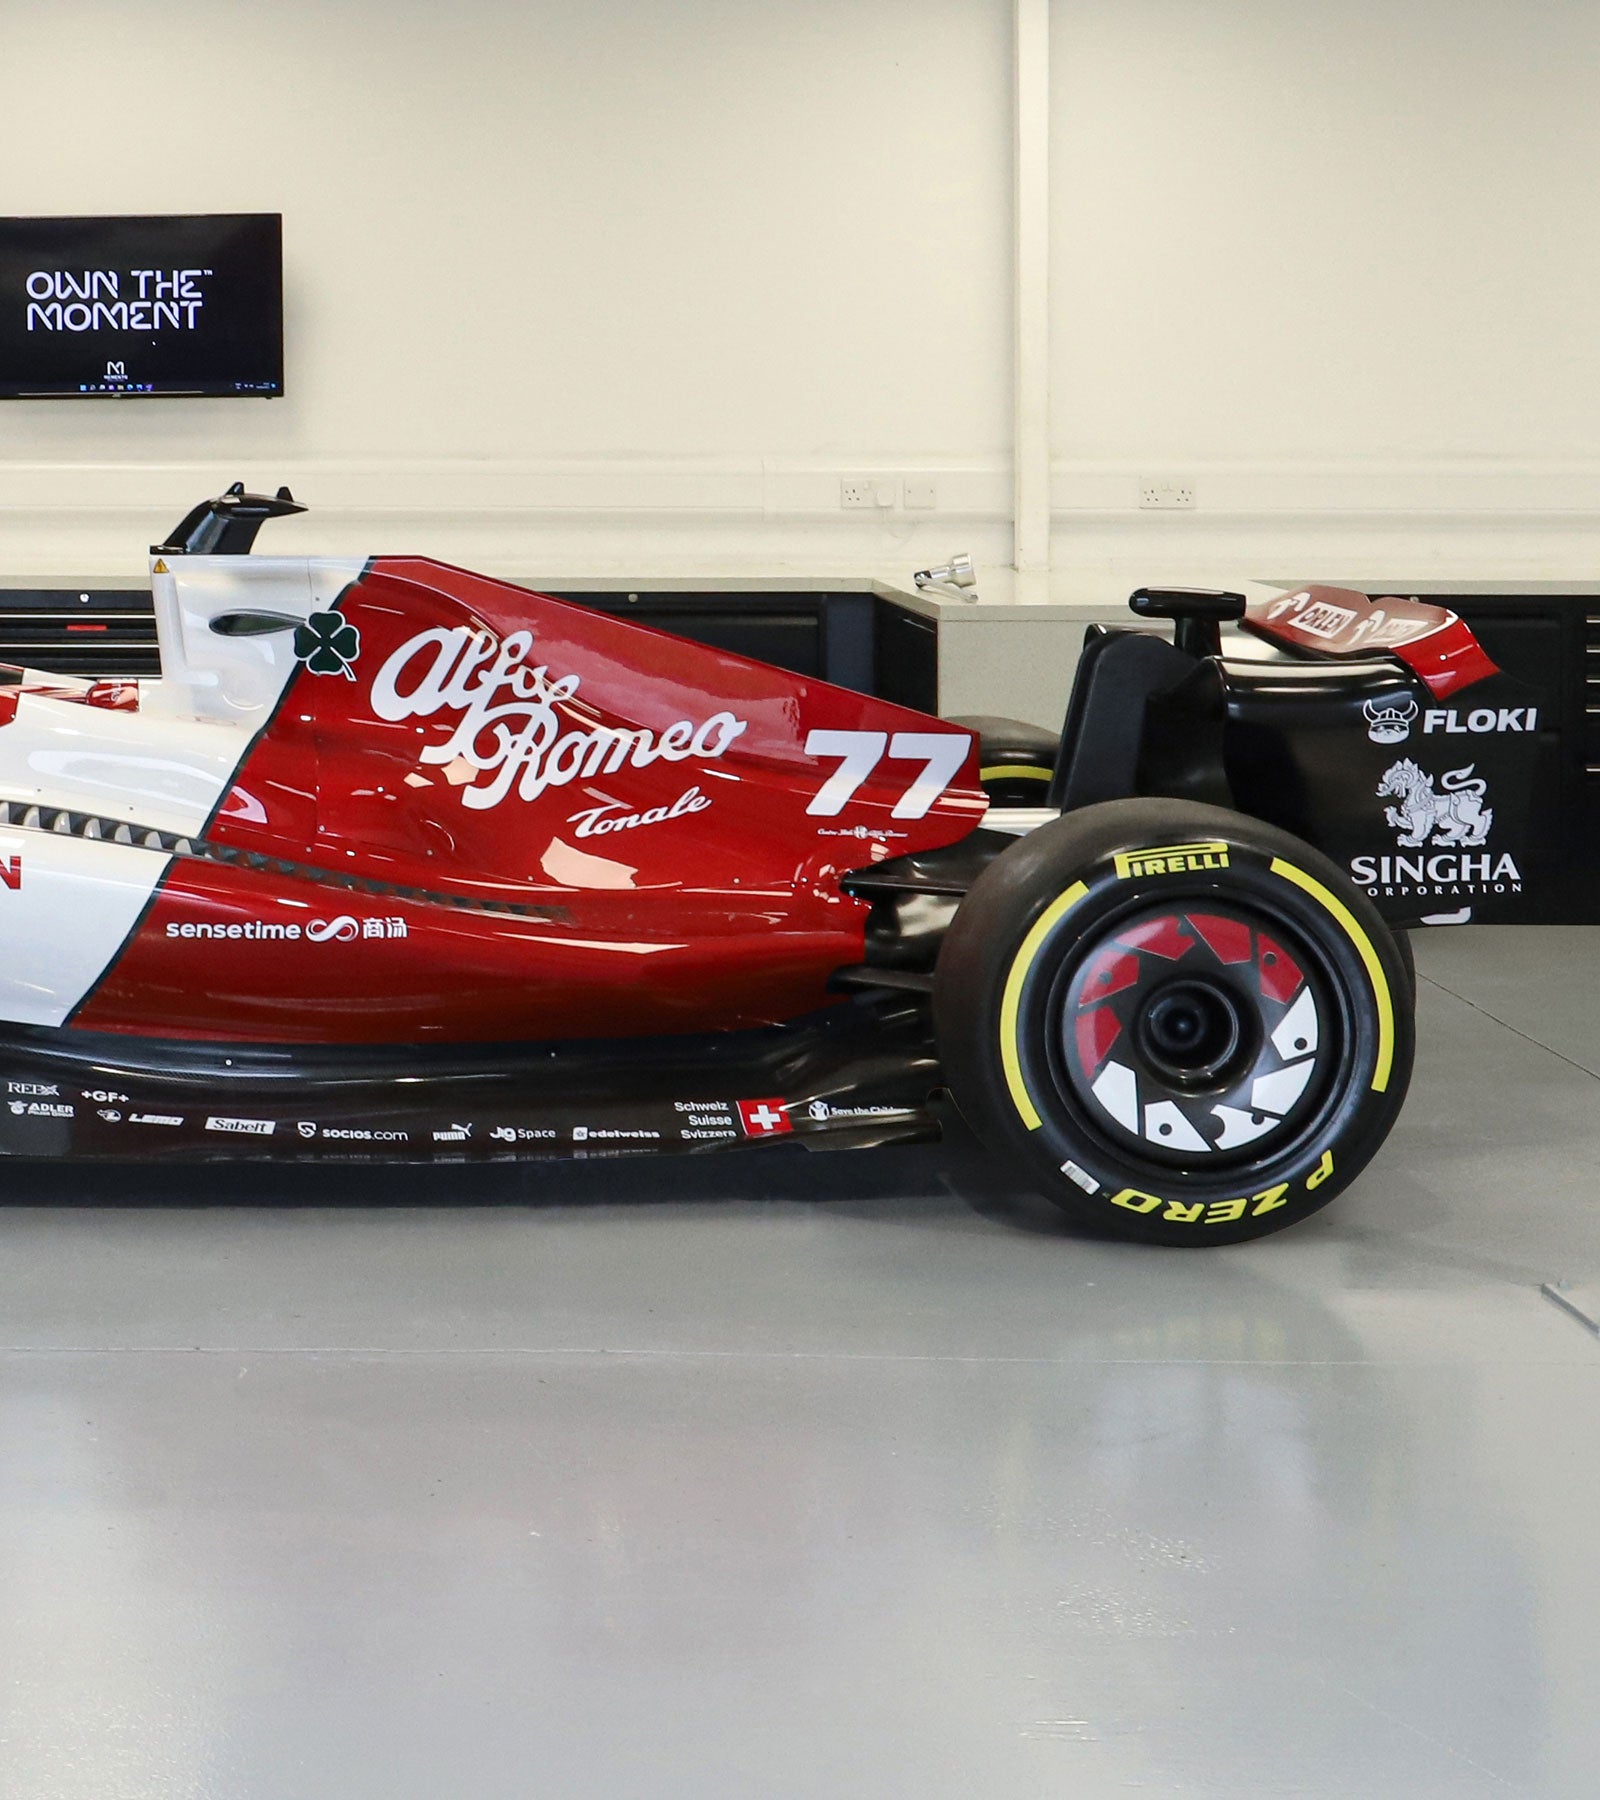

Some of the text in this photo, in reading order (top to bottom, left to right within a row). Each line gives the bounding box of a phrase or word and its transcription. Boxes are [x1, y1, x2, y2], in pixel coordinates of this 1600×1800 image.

[26, 271, 118, 299] OWN
[131, 269, 202, 298] THE
[27, 301, 202, 330] MOMENT
[1423, 708, 1537, 734] FLOKI
[419, 701, 748, 810] Romeo
[804, 729, 972, 819] 77
[566, 786, 712, 838] Tonale
[1113, 843, 1230, 880] PIRELLI
[1350, 852, 1521, 885] SINGHA
[1366, 883, 1522, 897] ORPORATION
[166, 920, 301, 940] sensetime
[28, 1102, 74, 1114] ADLER
[674, 1101, 729, 1112] Schweiz
[213, 1119, 266, 1133] Sabelt
[688, 1114, 733, 1126] Suisse
[322, 1128, 409, 1141] socios.com
[518, 1128, 556, 1140] Space
[588, 1129, 660, 1139] edelweiss
[680, 1129, 737, 1140] Svizzera
[1109, 1149, 1335, 1225] P ZERO
